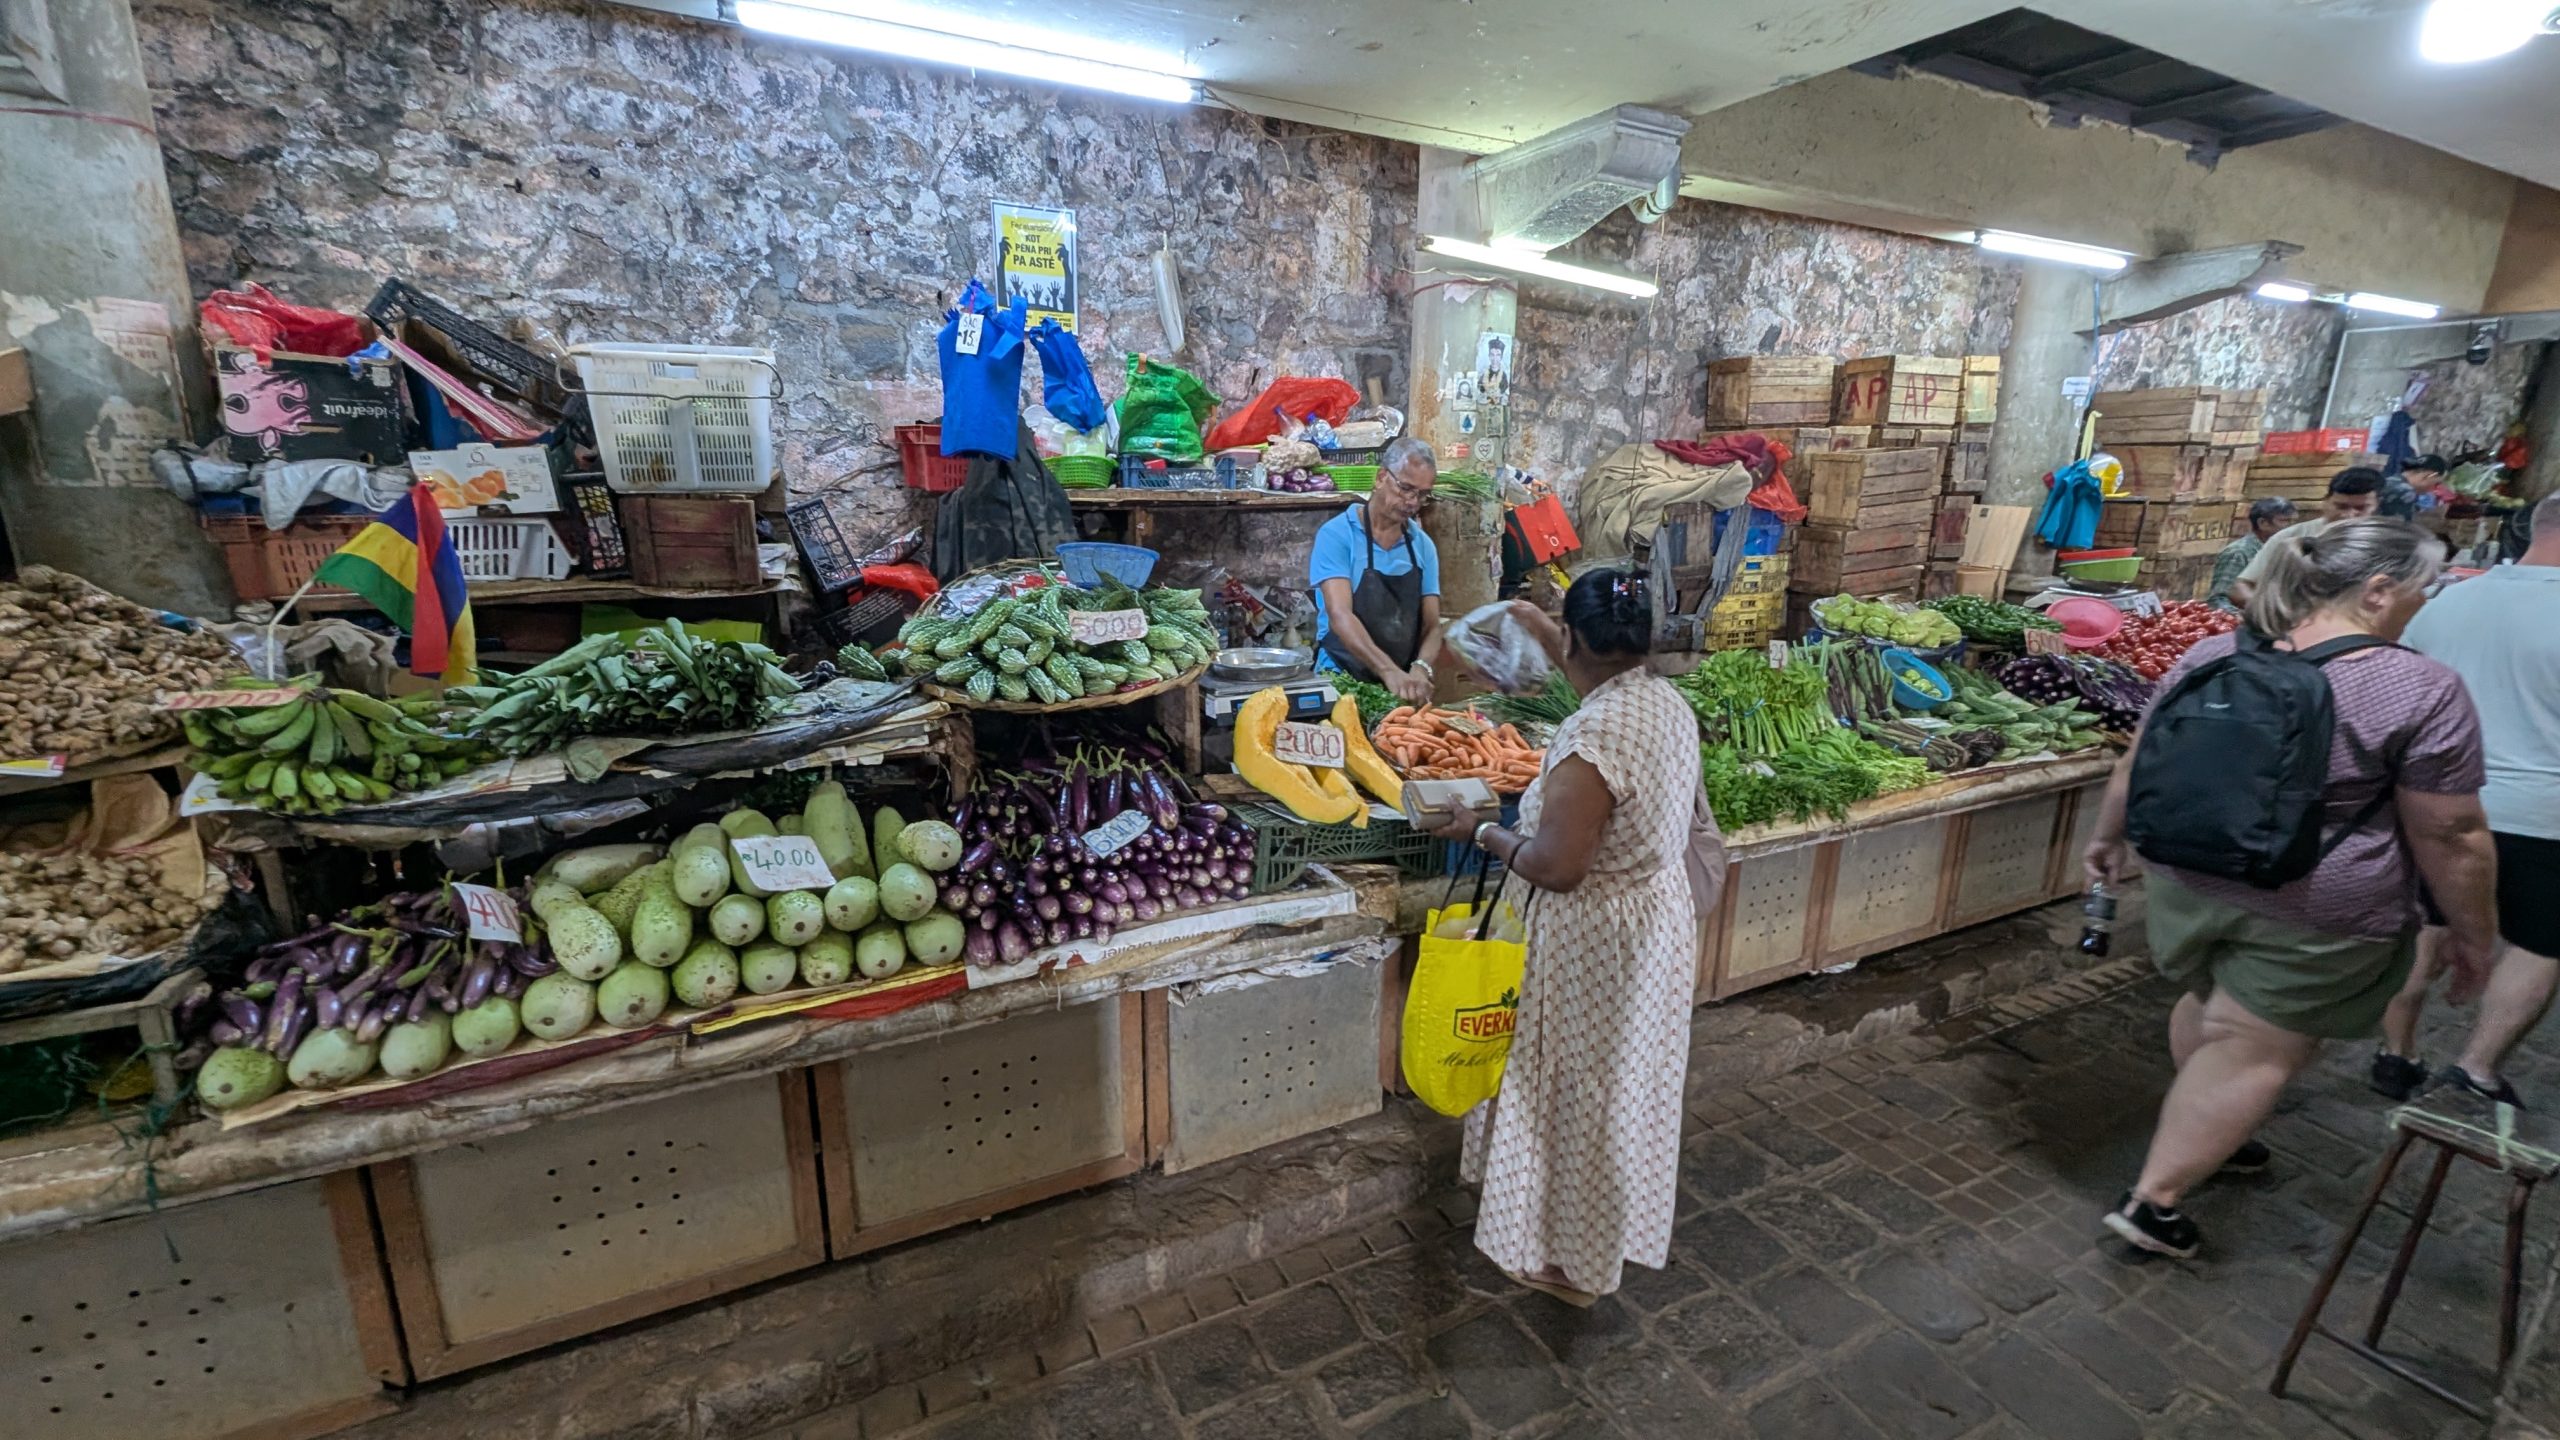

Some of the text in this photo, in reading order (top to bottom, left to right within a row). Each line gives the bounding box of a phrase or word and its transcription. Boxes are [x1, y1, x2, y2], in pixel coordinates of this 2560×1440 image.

[1025, 234, 1040, 243] KOT
[1038, 246, 1052, 255] PRI
[1013, 254, 1055, 269] PA ASTÉ
[1846, 376, 1887, 411] AP
[1902, 372, 1938, 421] AP
[322, 402, 389, 419] ideafruit
